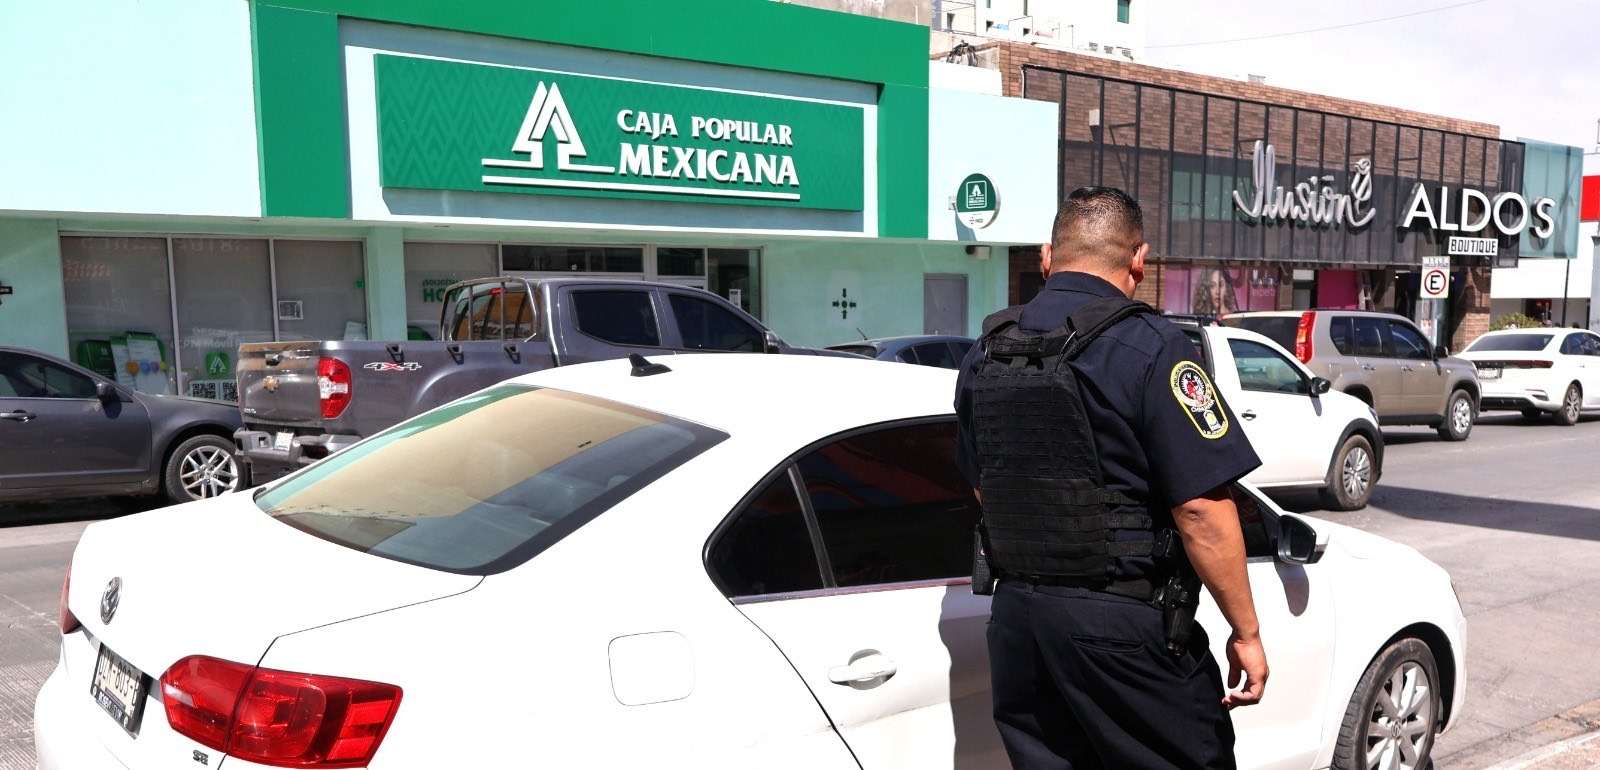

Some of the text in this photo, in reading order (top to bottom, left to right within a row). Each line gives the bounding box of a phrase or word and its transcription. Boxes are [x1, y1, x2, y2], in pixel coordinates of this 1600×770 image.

[617, 109, 793, 146] CAJA POPULAR
[618, 142, 800, 186] MEXICANA
[1451, 239, 1497, 253] BOUTIQUE
[1430, 275, 1441, 290] E
